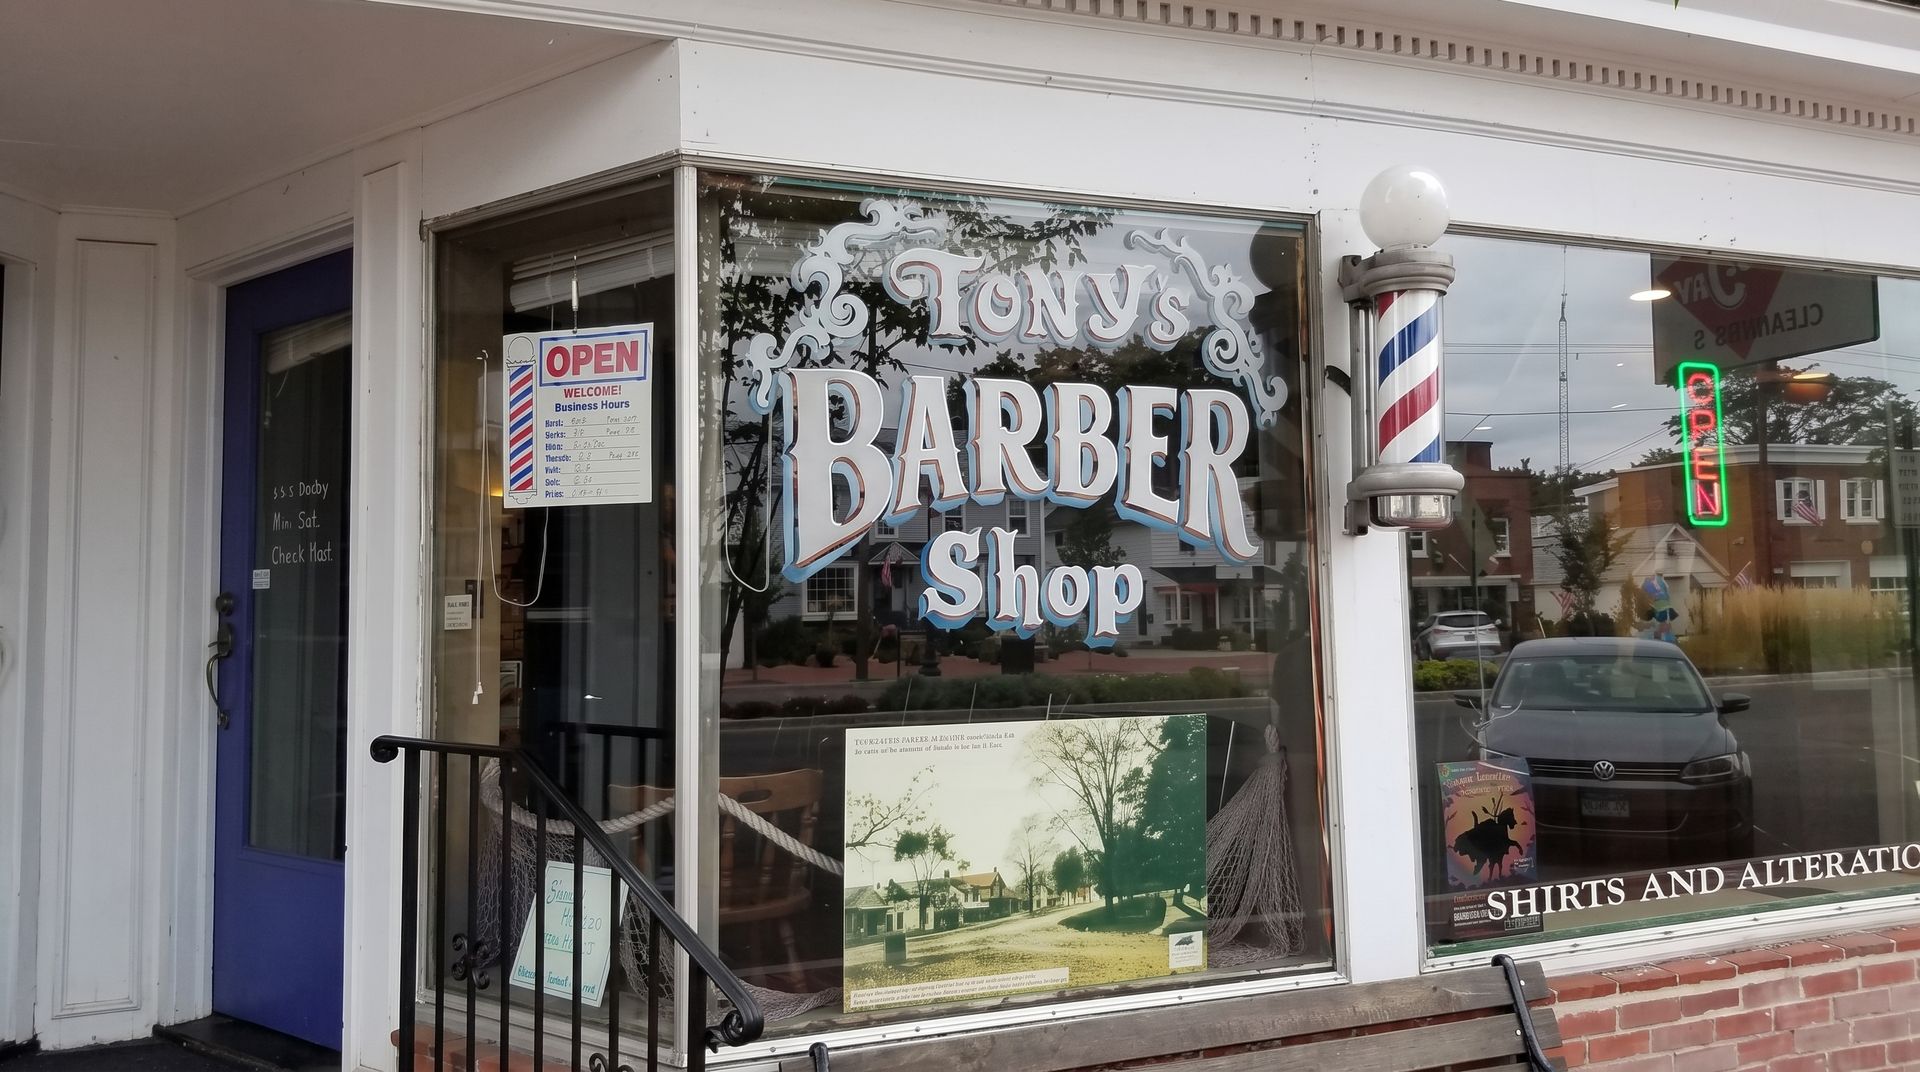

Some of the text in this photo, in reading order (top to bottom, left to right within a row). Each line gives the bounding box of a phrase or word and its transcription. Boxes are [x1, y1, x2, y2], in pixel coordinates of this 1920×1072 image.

[546, 340, 639, 378] OPEN
[554, 400, 631, 413] Business Hours
[563, 385, 622, 399] WELCOME!
[779, 368, 1260, 582] BARBER
[271, 544, 305, 565] Check
[918, 526, 1144, 649] Shop
[1487, 843, 1920, 921] SHIRTS AND ALTERATIO
